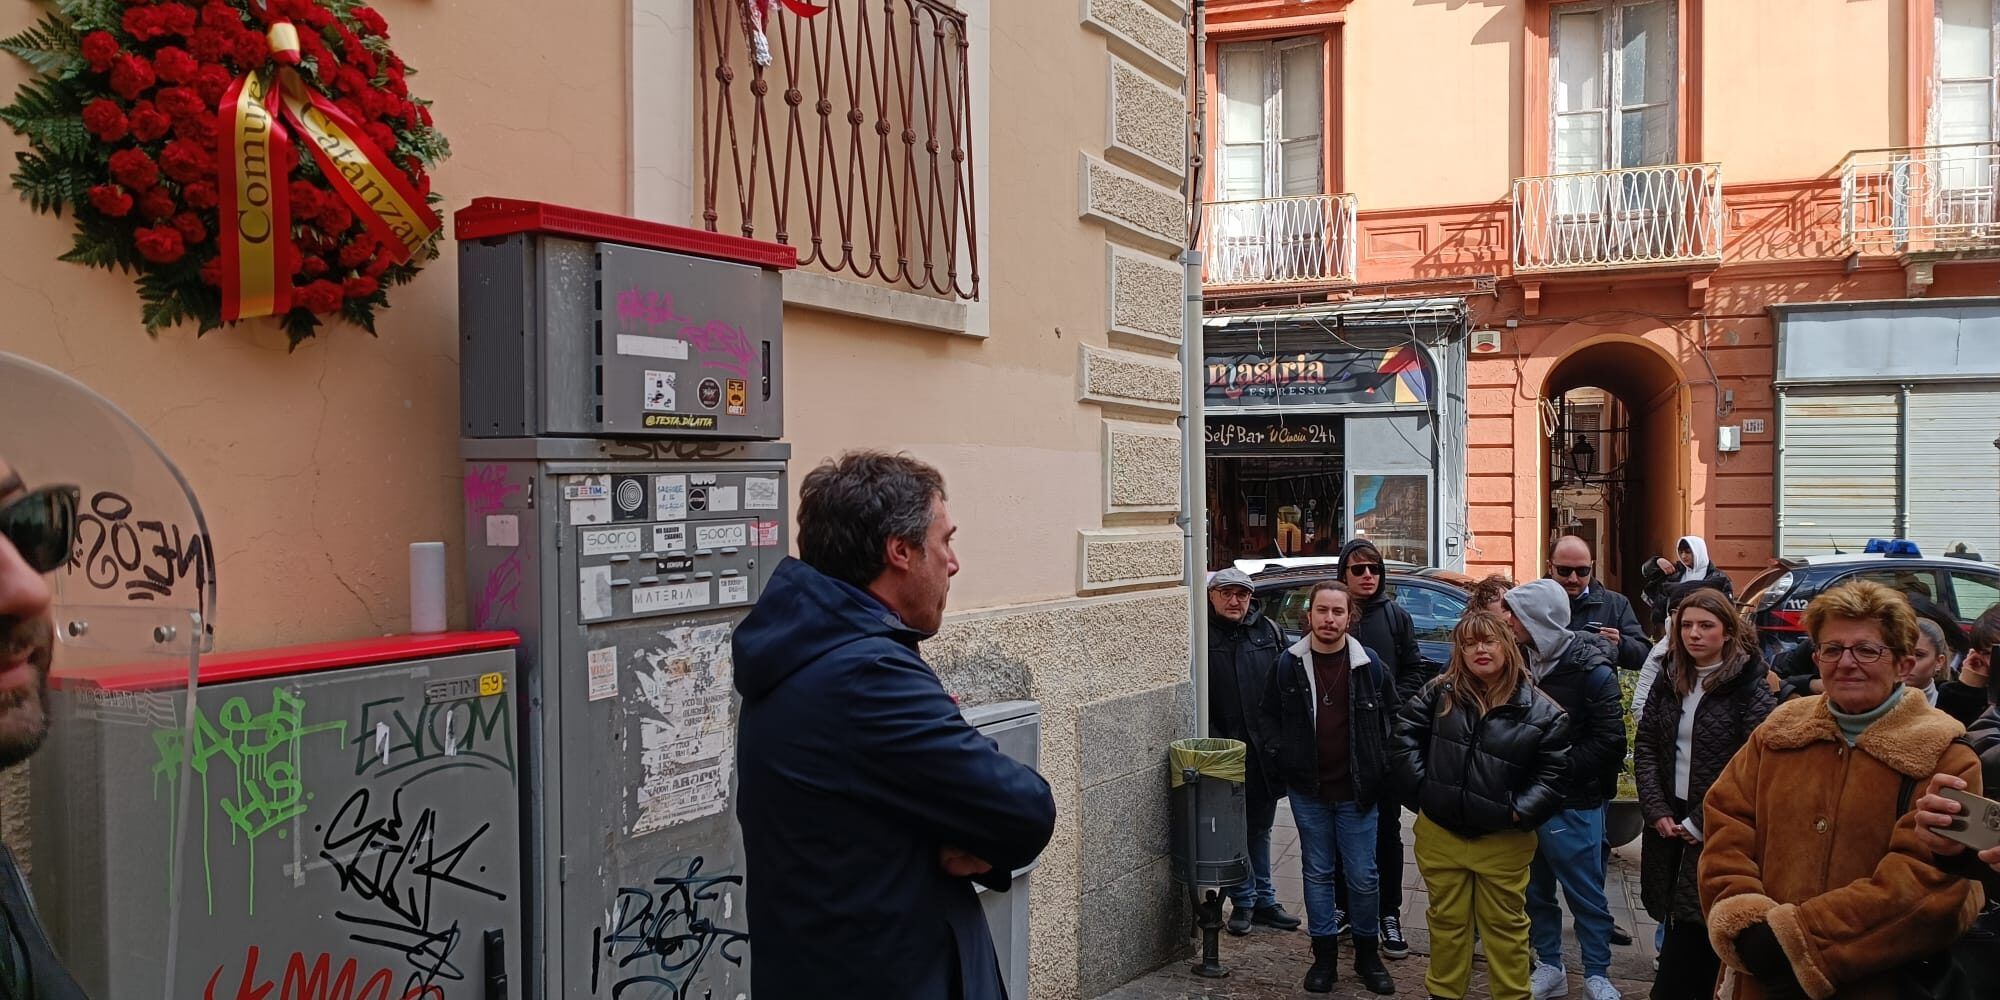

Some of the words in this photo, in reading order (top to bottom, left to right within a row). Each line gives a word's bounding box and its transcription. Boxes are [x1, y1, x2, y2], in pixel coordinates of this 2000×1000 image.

[1208, 354, 1325, 385] mastria
[1250, 386, 1327, 397] ESPRESSO
[1204, 424, 1235, 446] Self
[1237, 425, 1265, 443] Bar
[589, 486, 602, 495] TIM
[1788, 599, 1809, 609] 112
[448, 679, 477, 697] TIM
